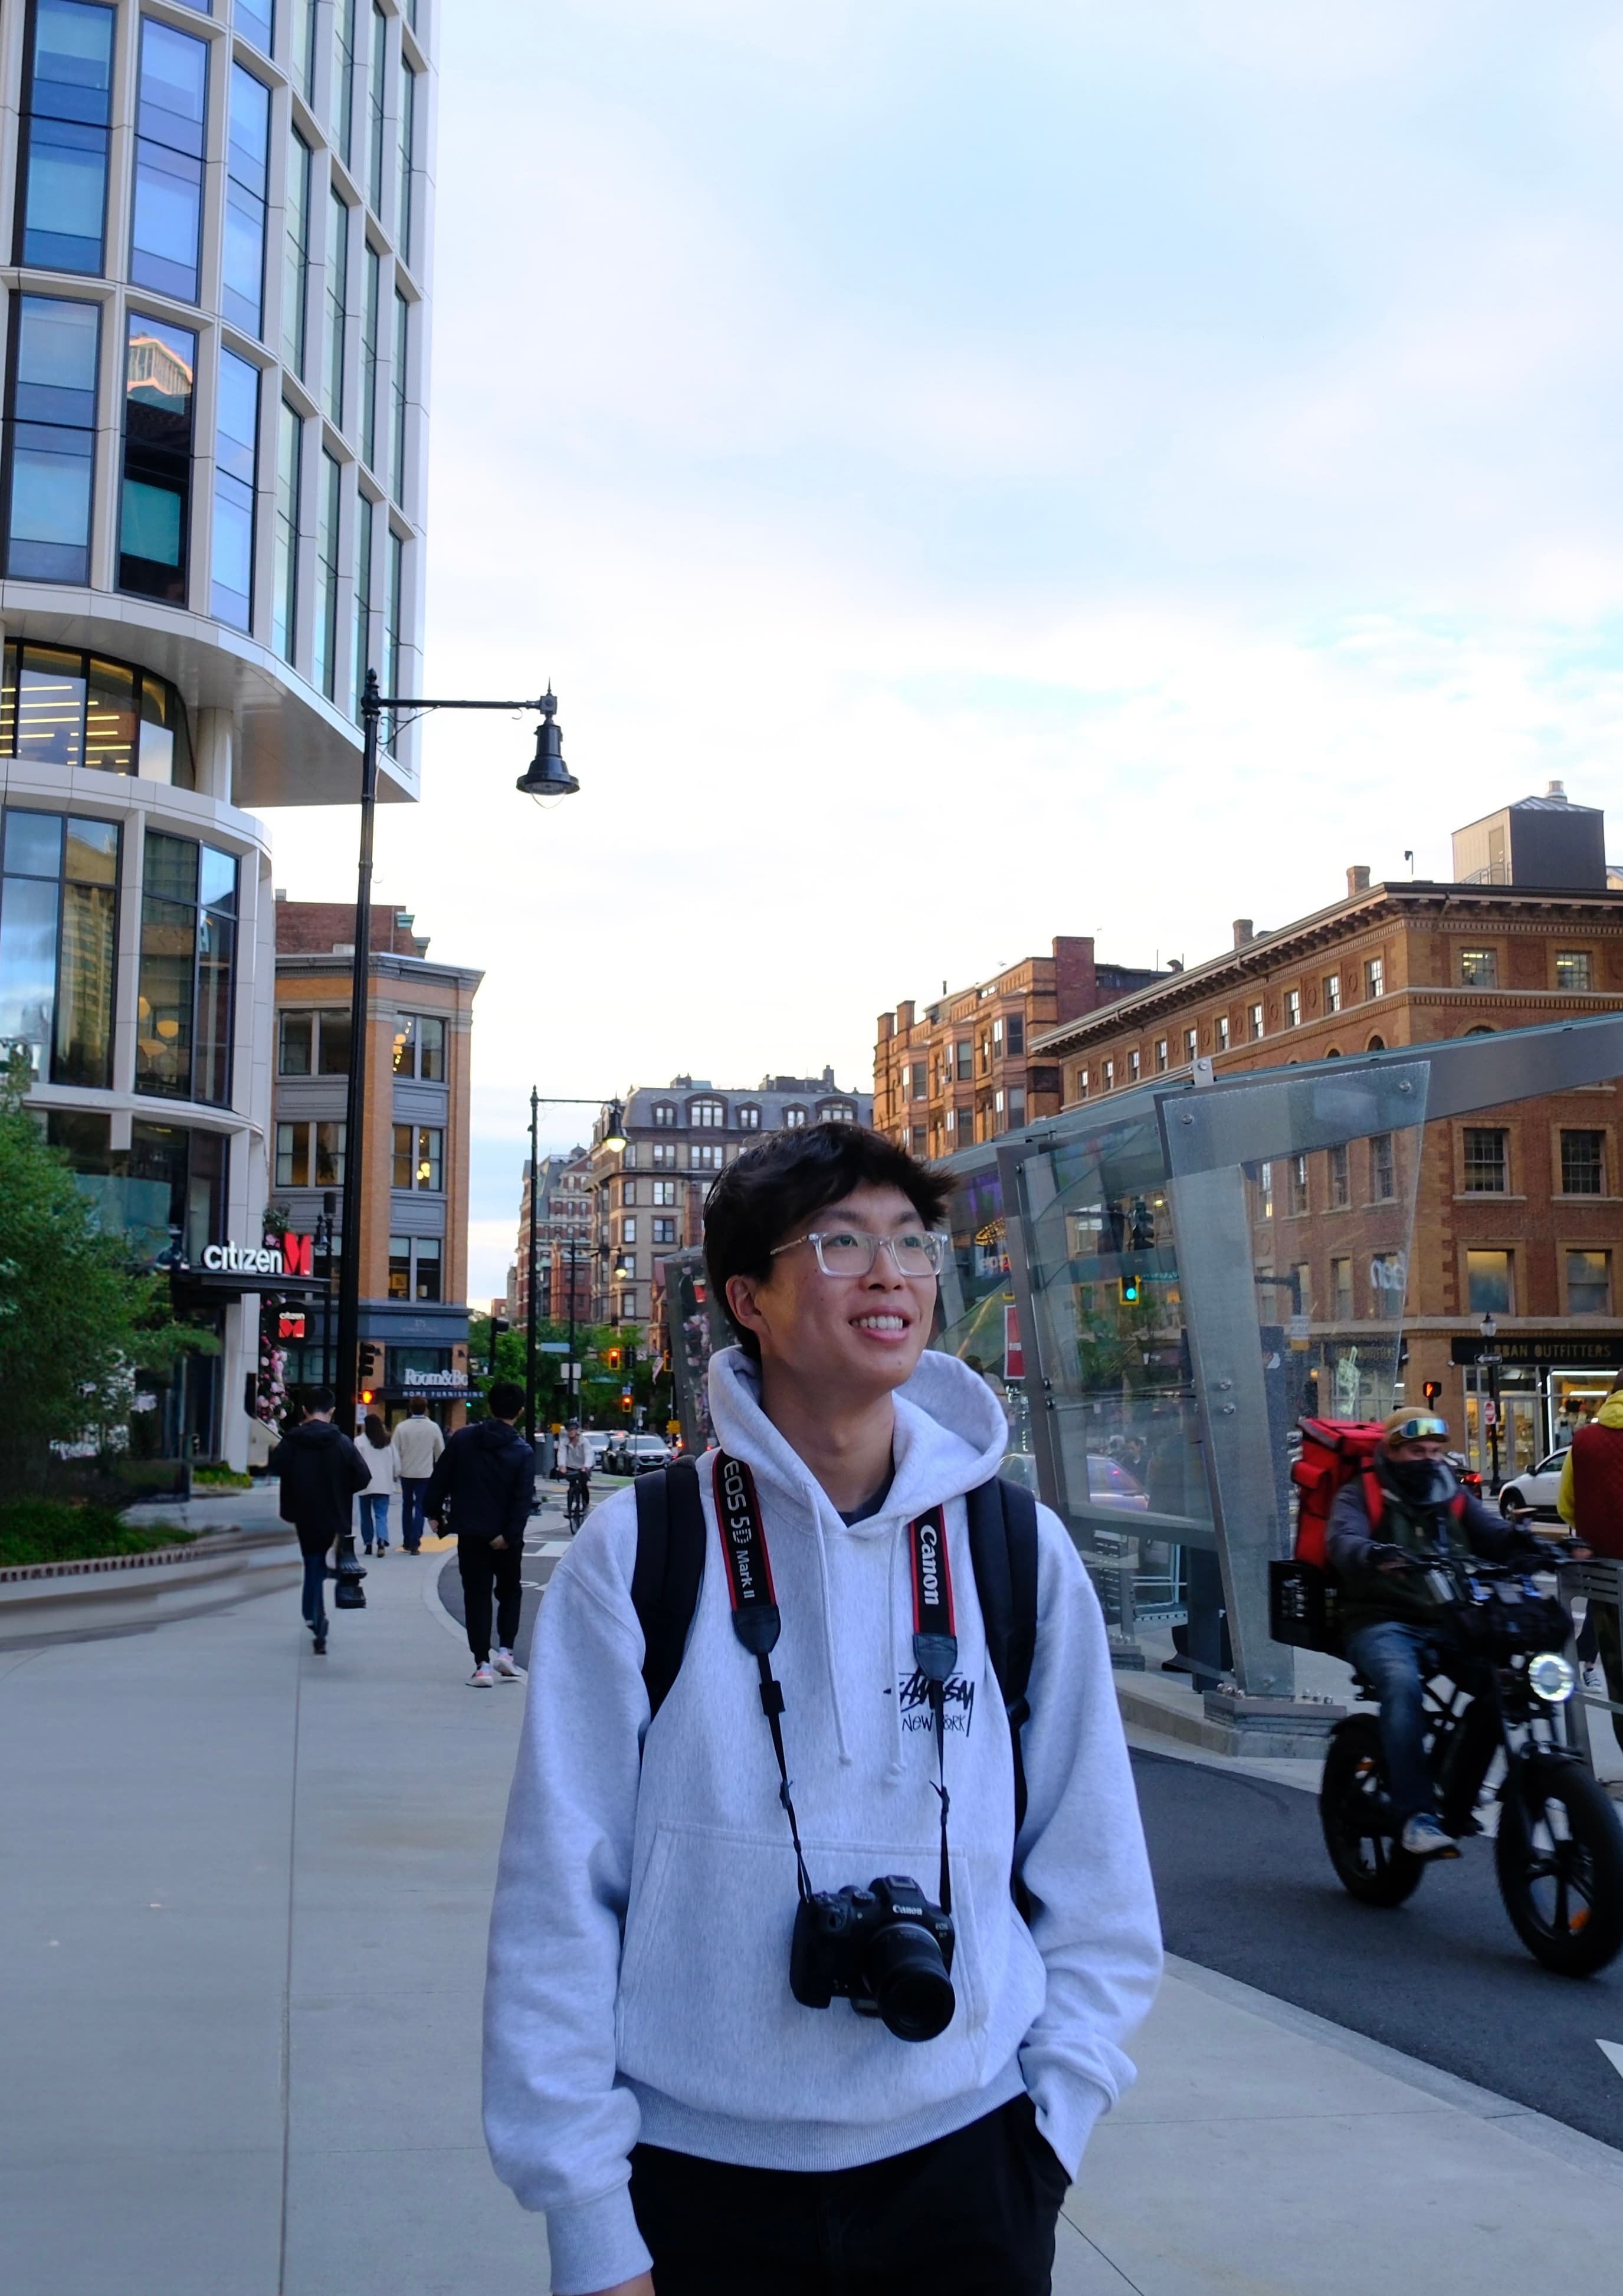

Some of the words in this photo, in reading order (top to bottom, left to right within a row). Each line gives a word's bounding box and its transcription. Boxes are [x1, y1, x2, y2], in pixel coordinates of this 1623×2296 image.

[1534, 1344, 1611, 1357] OUTFITTERS
[724, 1460, 746, 1511] EOS
[730, 1516, 752, 1544] 5D
[736, 1550, 753, 1588] Mark
[920, 1524, 939, 1606] Canon
[743, 1589, 755, 1599] II
[942, 1713, 966, 1733] ORK
[892, 1904, 923, 1916] Canon
